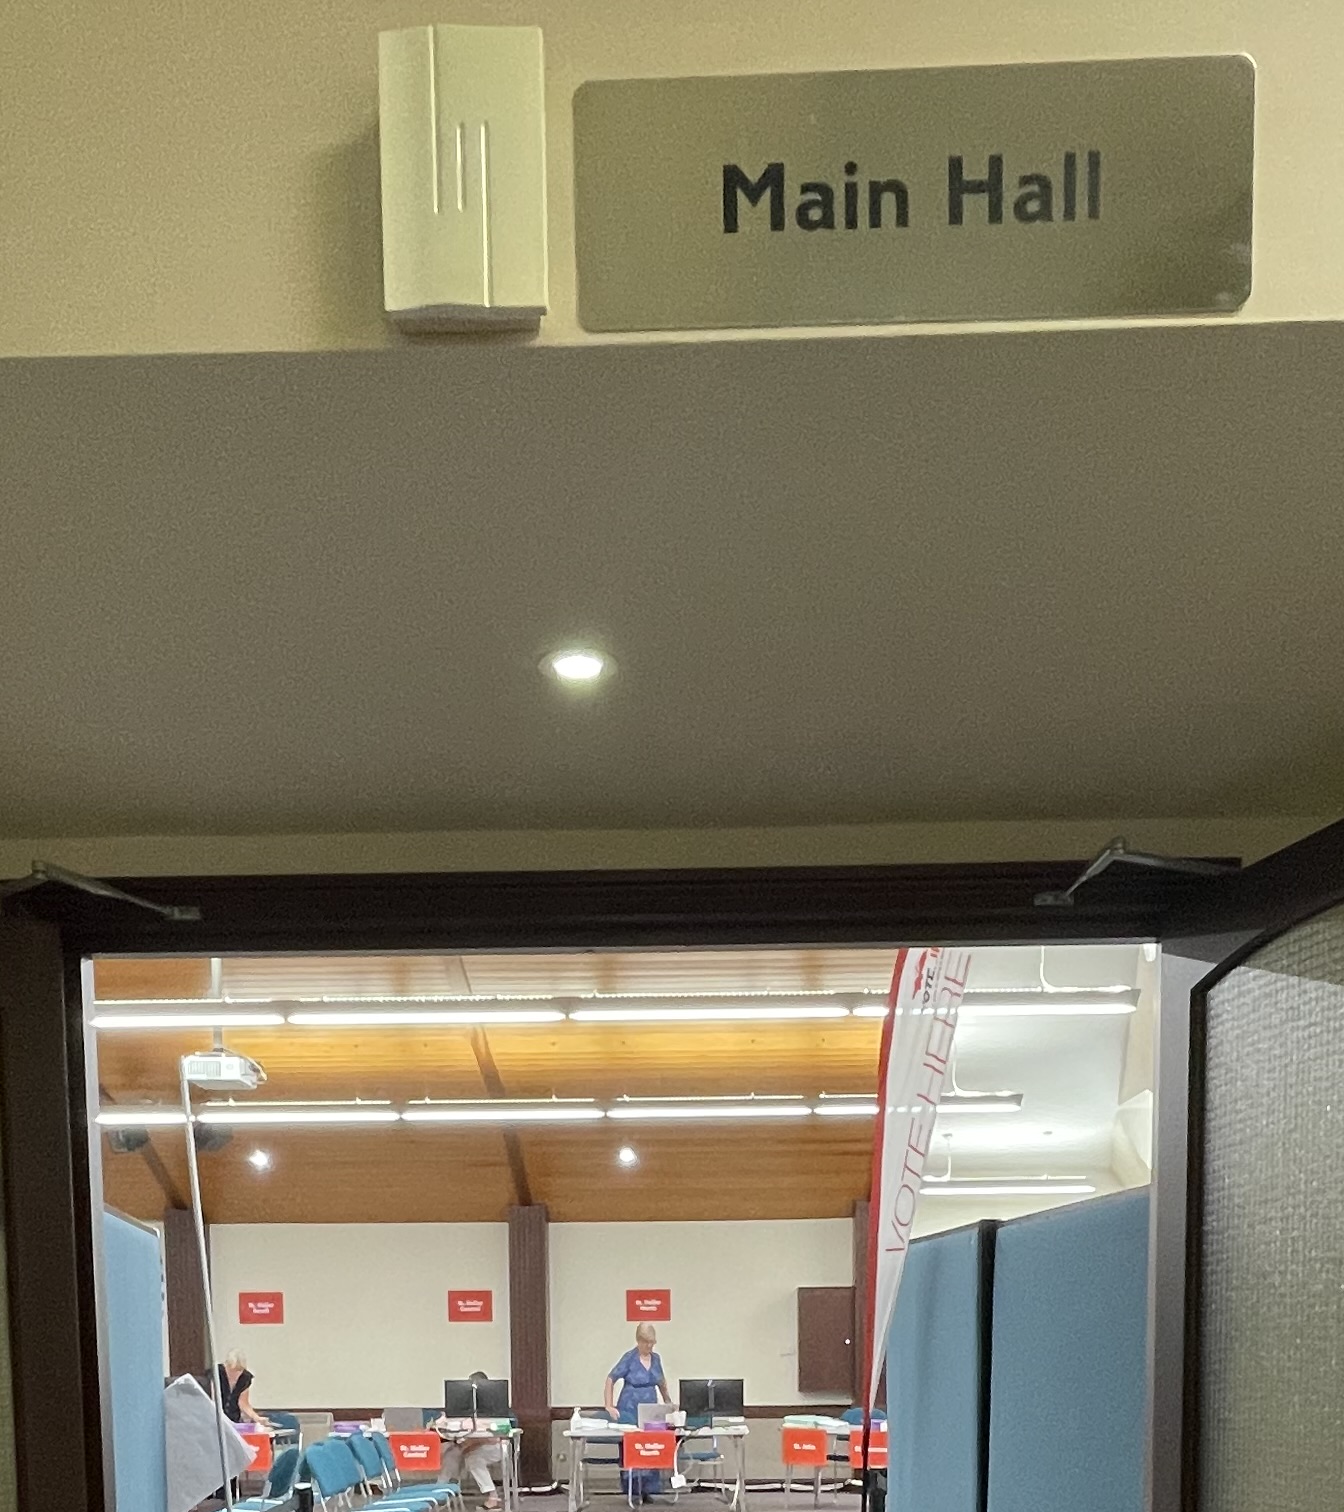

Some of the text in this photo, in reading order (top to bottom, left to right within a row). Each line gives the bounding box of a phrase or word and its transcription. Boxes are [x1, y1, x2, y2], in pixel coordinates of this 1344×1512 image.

[722, 149, 1101, 234] Main Hall
[885, 953, 972, 1252] VOTE HERE
